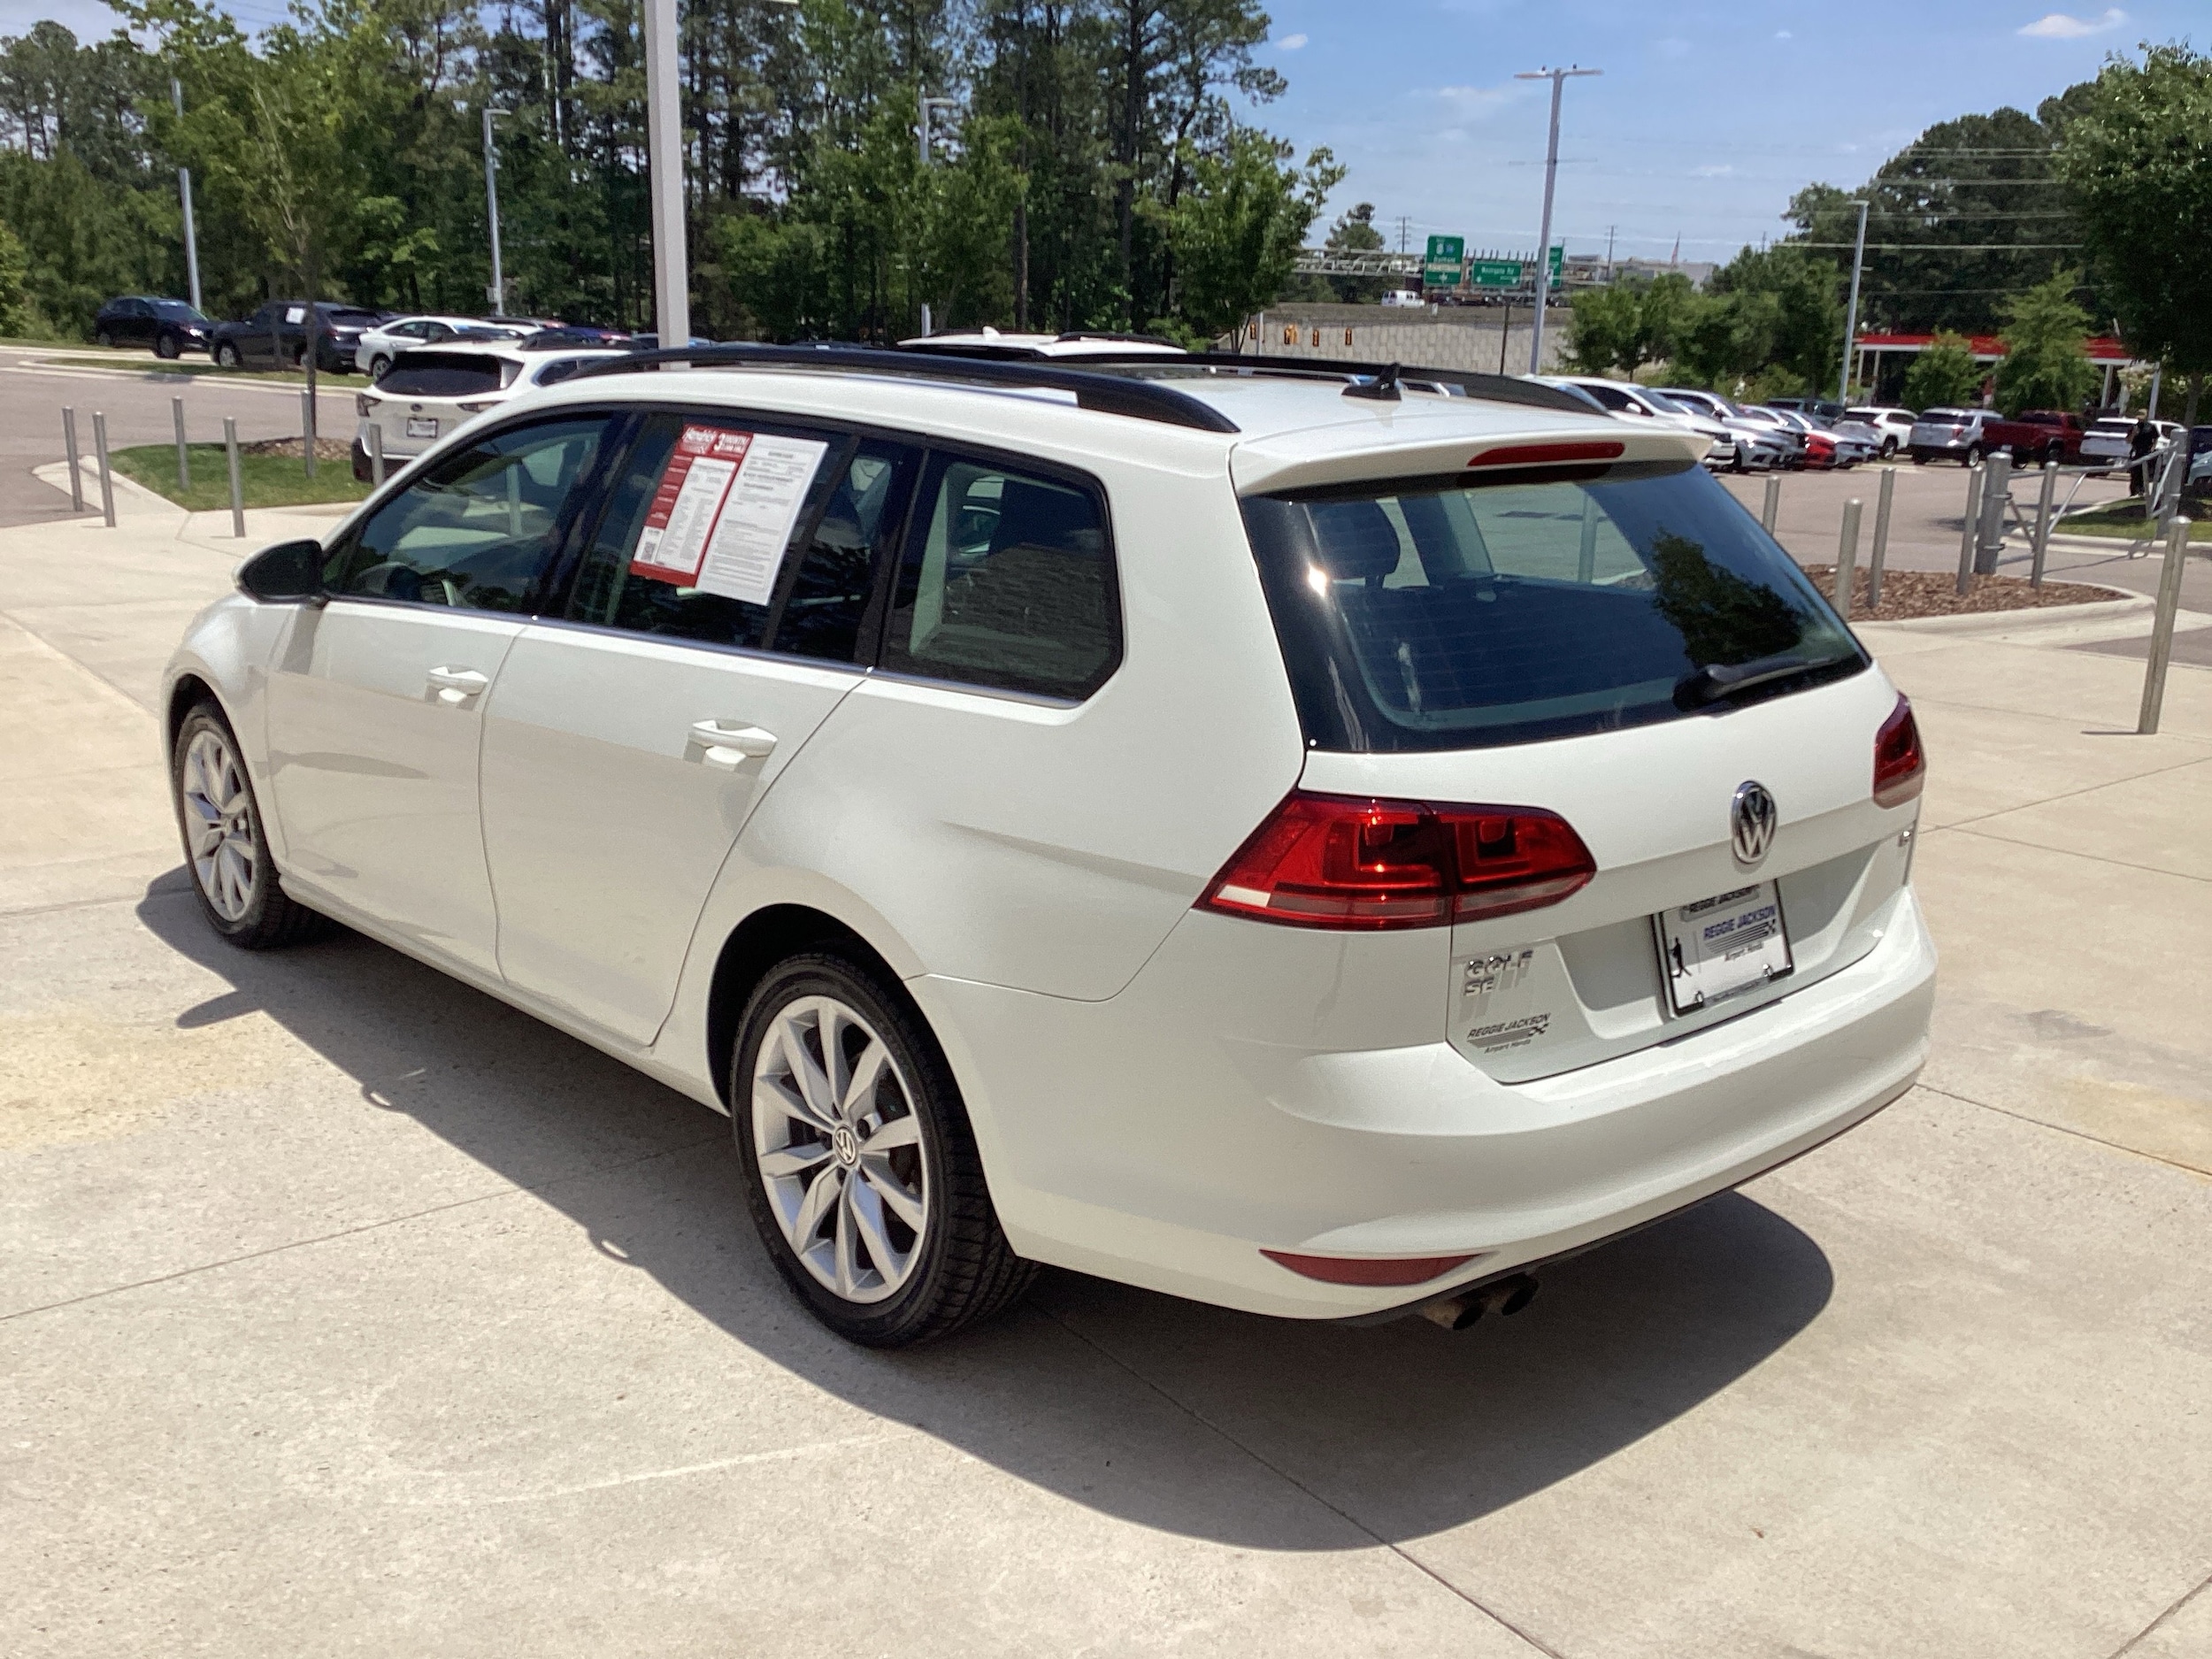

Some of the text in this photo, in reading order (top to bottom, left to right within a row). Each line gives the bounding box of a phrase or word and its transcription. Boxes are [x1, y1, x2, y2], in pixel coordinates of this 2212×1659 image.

[1703, 904, 1777, 941] REGGIE JACKSON
[1465, 949, 1533, 978] GOLF
[1467, 1012, 1551, 1039] REGGIE JACKSON
